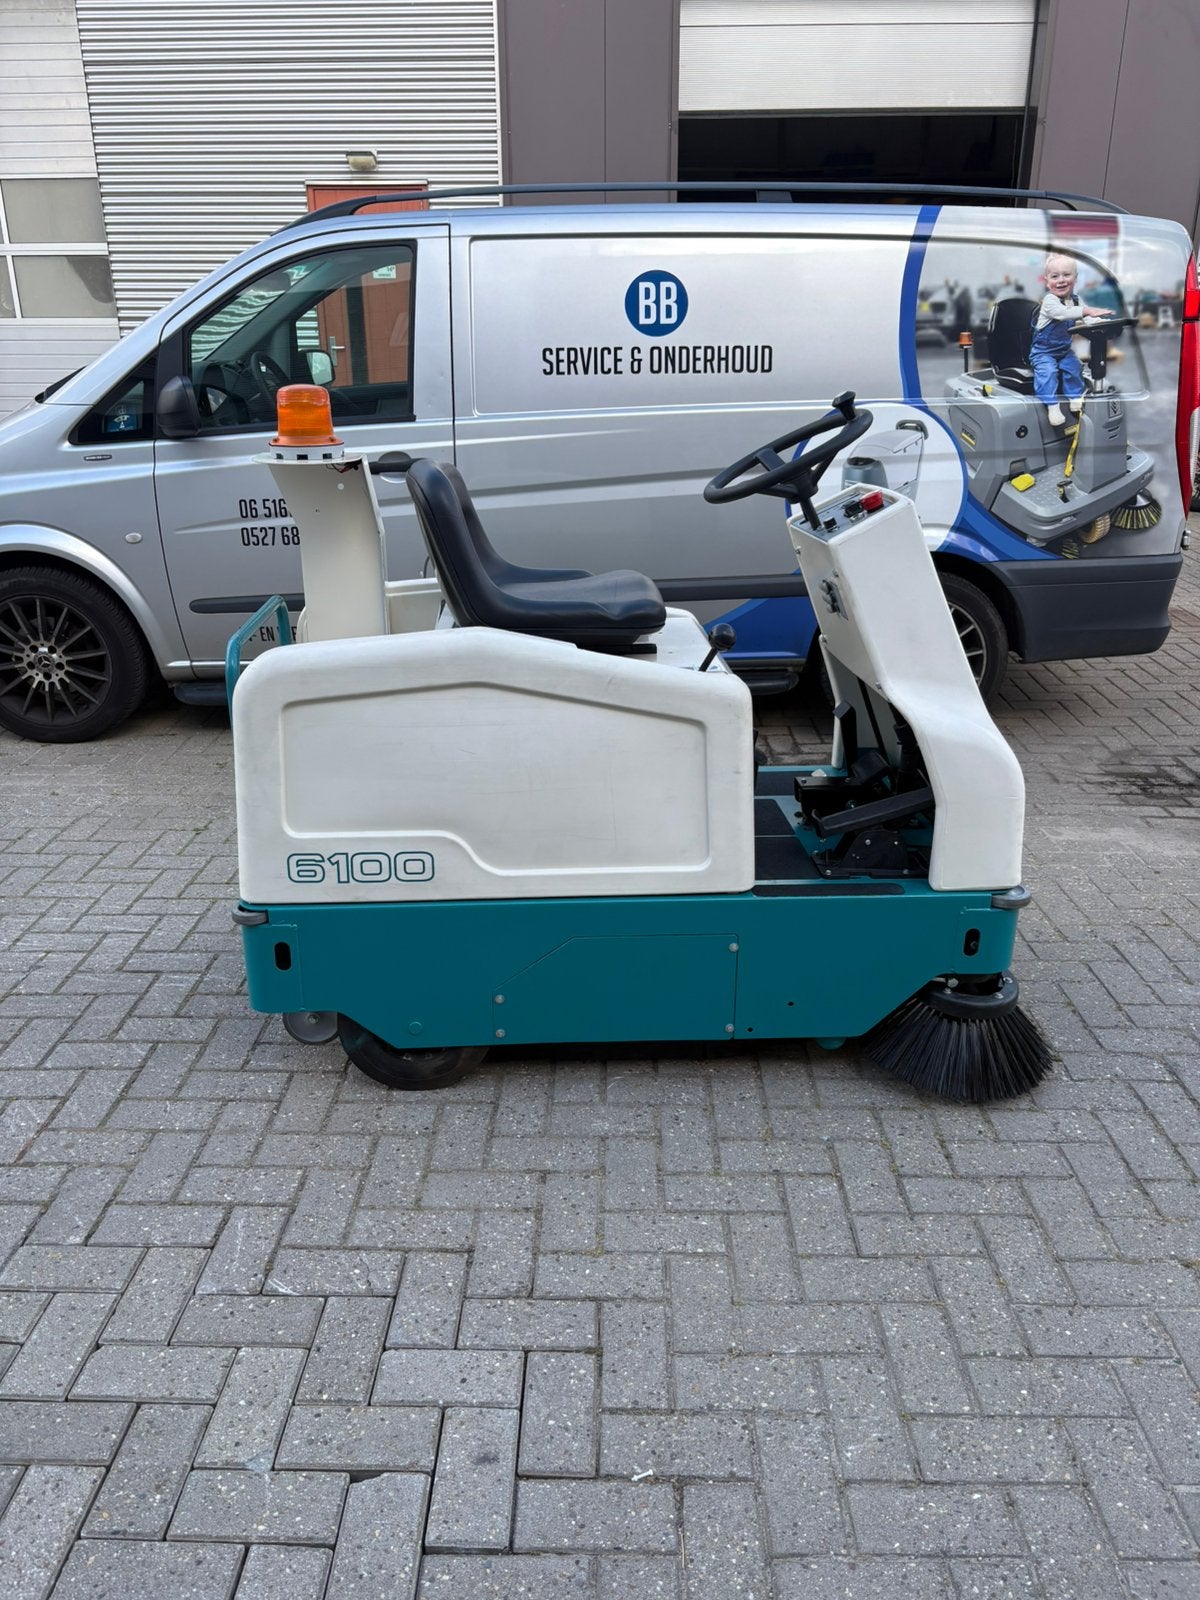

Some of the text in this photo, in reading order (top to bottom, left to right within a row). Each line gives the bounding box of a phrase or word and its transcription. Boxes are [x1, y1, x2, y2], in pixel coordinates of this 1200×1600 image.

[638, 281, 678, 325] BB
[542, 344, 773, 375] SERVICE & ONDERHOUD
[238, 498, 293, 519] 06 516
[240, 526, 276, 546] 0527
[260, 626, 275, 642] EN
[287, 851, 435, 884] 6100
